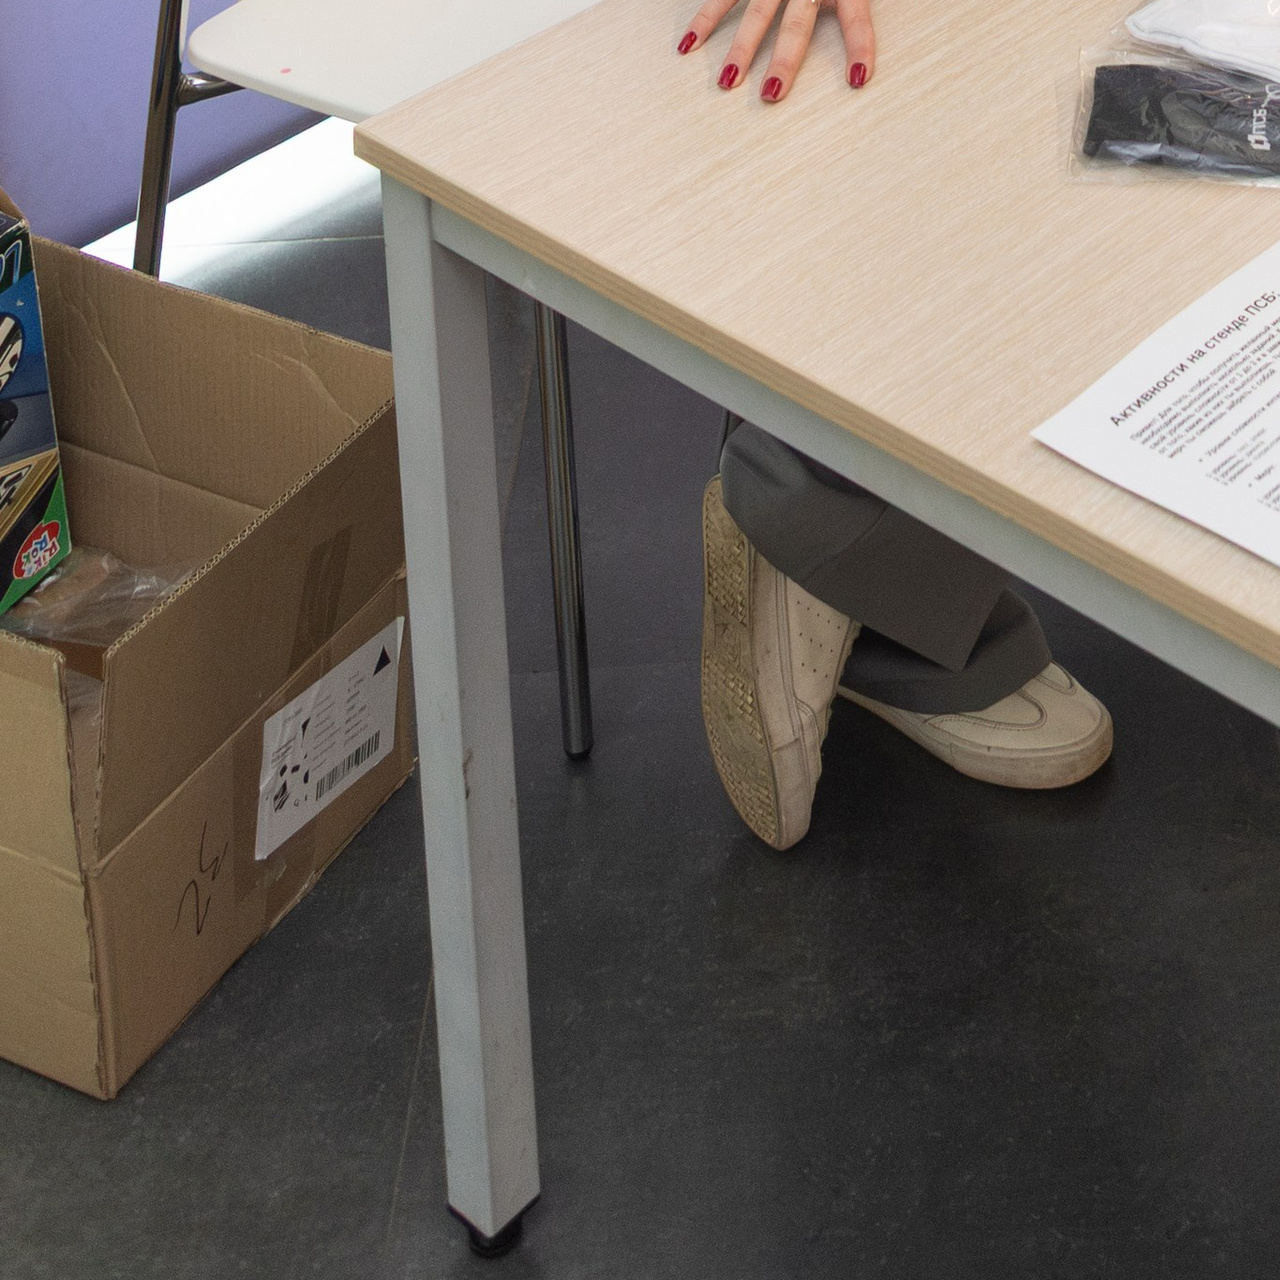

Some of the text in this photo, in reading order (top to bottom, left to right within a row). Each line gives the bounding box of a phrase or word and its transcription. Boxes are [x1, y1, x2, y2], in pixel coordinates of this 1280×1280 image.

[1252, 108, 1268, 136] ПСБ
[1110, 363, 1188, 427] Активности
[1187, 348, 1207, 365] на
[1204, 313, 1249, 349] стенде
[1245, 290, 1280, 317] ПСБ:
